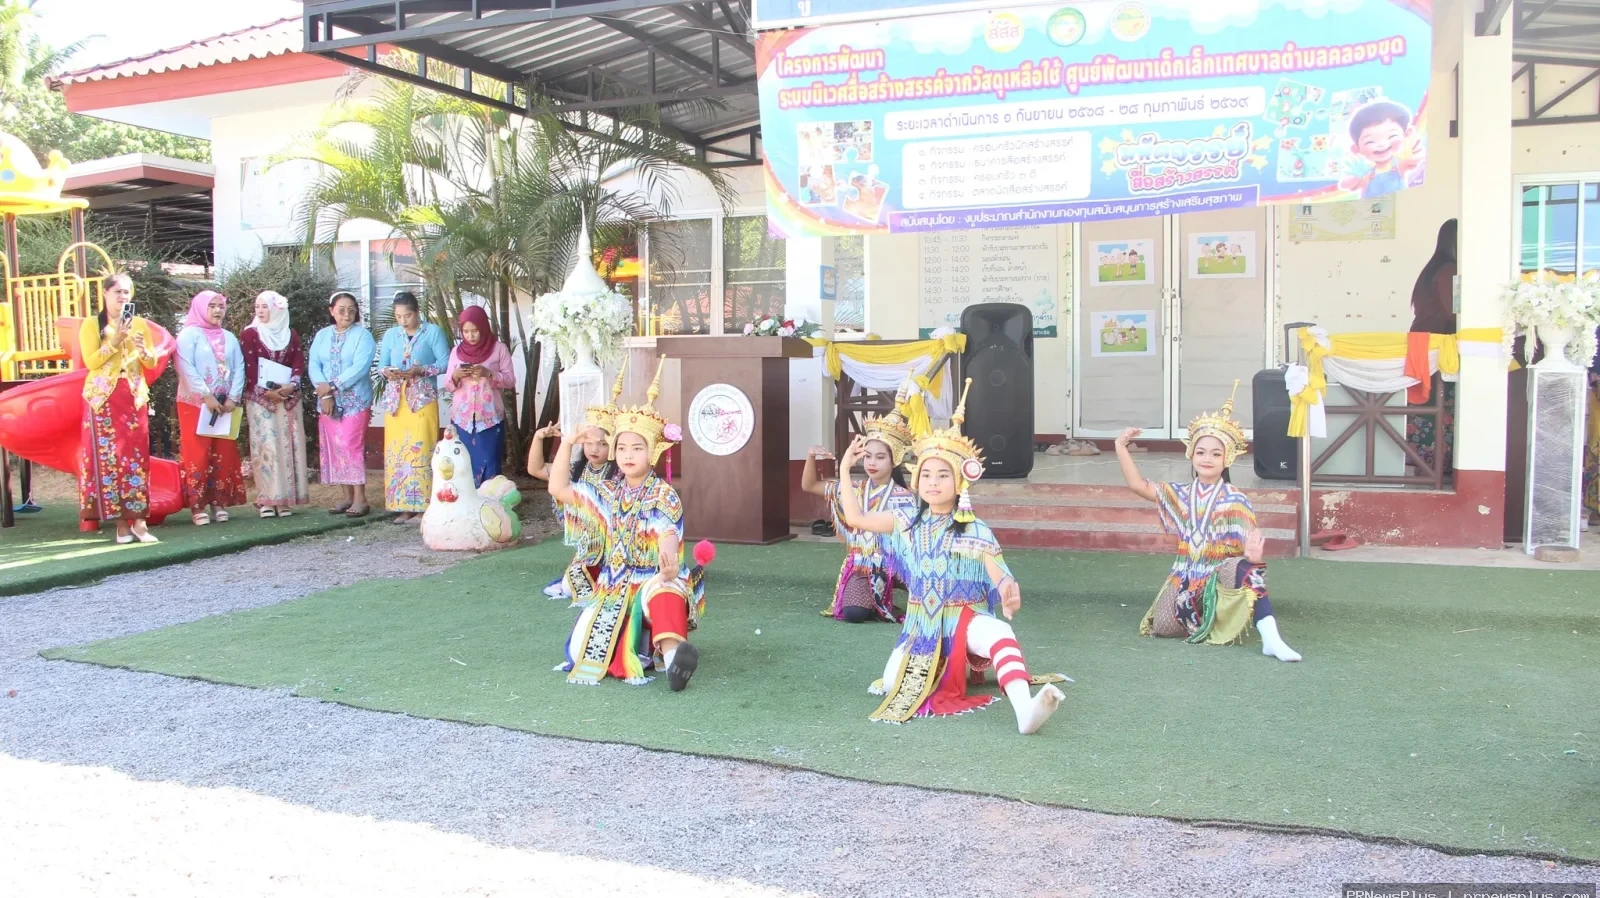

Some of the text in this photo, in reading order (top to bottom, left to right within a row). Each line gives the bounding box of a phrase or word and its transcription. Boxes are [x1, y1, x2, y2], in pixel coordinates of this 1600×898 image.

[777, 46, 884, 77] โครงการพัฒนา
[779, 36, 1406, 109] ระบบนิเวศสื่อสร้างสรรค์จากวัสดุเหลือใช้ ศูนย์พัฒนาเด็กเล็กเทศบาลตำบลคลองขุด
[897, 112, 999, 131] ระยะเวลาดำเนินการ
[1016, 108, 1064, 123] กันยายน
[1068, 105, 1104, 119] ๒๕๖๘
[1119, 102, 1138, 115] ๒๘
[1143, 95, 1204, 119] กุมภาพันธ์
[1210, 96, 1249, 110] ๒๕๖๙
[930, 144, 965, 156] กิจกรรม
[930, 158, 966, 170] กิจกรรม
[930, 173, 966, 185] กิจกรรม
[1129, 160, 1239, 191] สื่อสร้างสรรค์
[929, 188, 964, 199] กิจกรรม
[900, 213, 955, 228] สนับสนุนโดย
